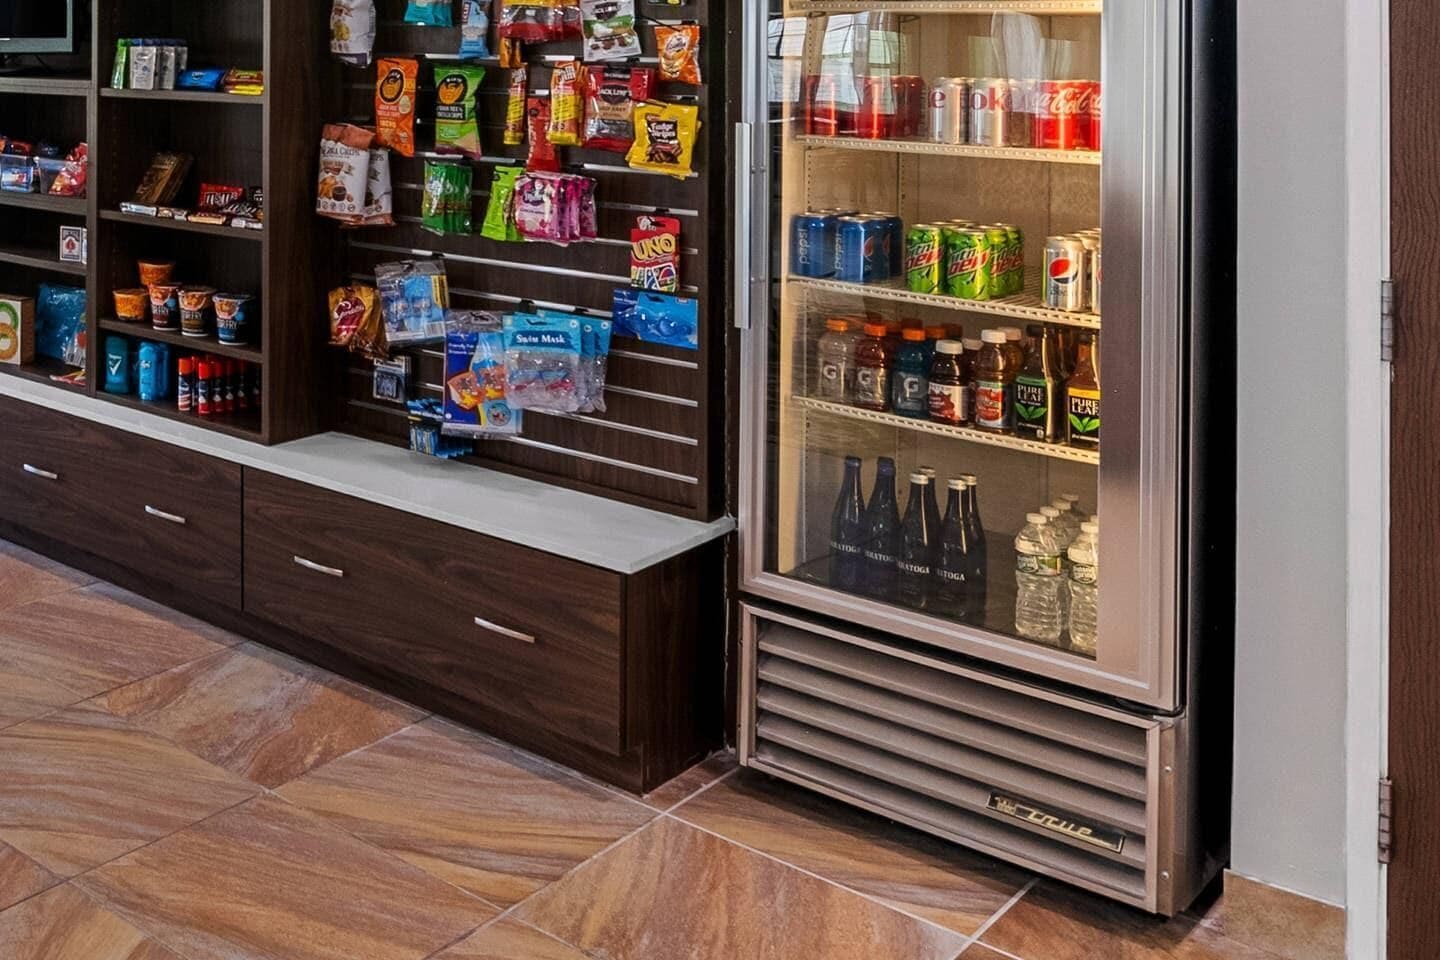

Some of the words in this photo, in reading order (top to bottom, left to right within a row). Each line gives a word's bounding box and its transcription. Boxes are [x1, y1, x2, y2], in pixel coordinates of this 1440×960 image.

[631, 233, 676, 261] UNO
[1017, 384, 1043, 395] PURE
[1071, 397, 1099, 409] PURE
